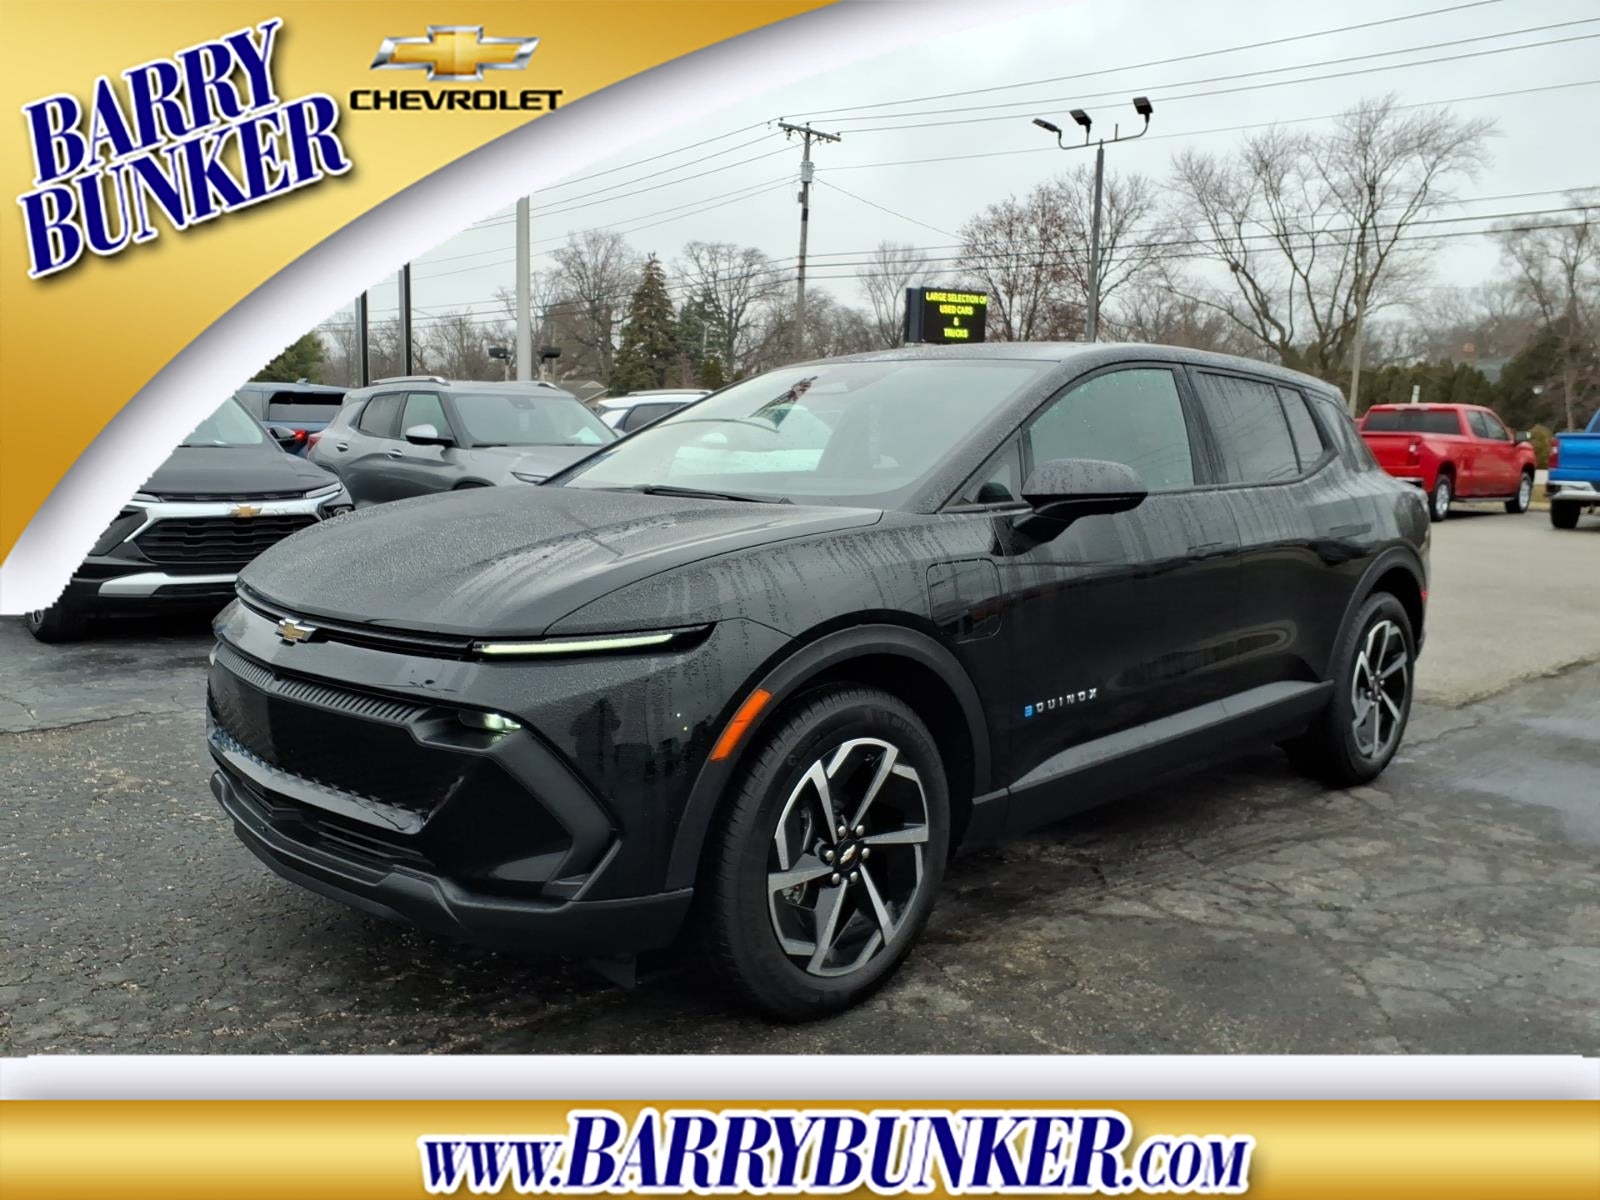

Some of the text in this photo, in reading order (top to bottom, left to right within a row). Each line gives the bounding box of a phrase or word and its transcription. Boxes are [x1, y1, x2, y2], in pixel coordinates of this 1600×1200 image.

[926, 291, 987, 305] LARGE SELECTION OF
[940, 304, 974, 316] USED CARS
[943, 327, 969, 339] TRUCKS
[1024, 687, 1098, 718] EQUINOX
